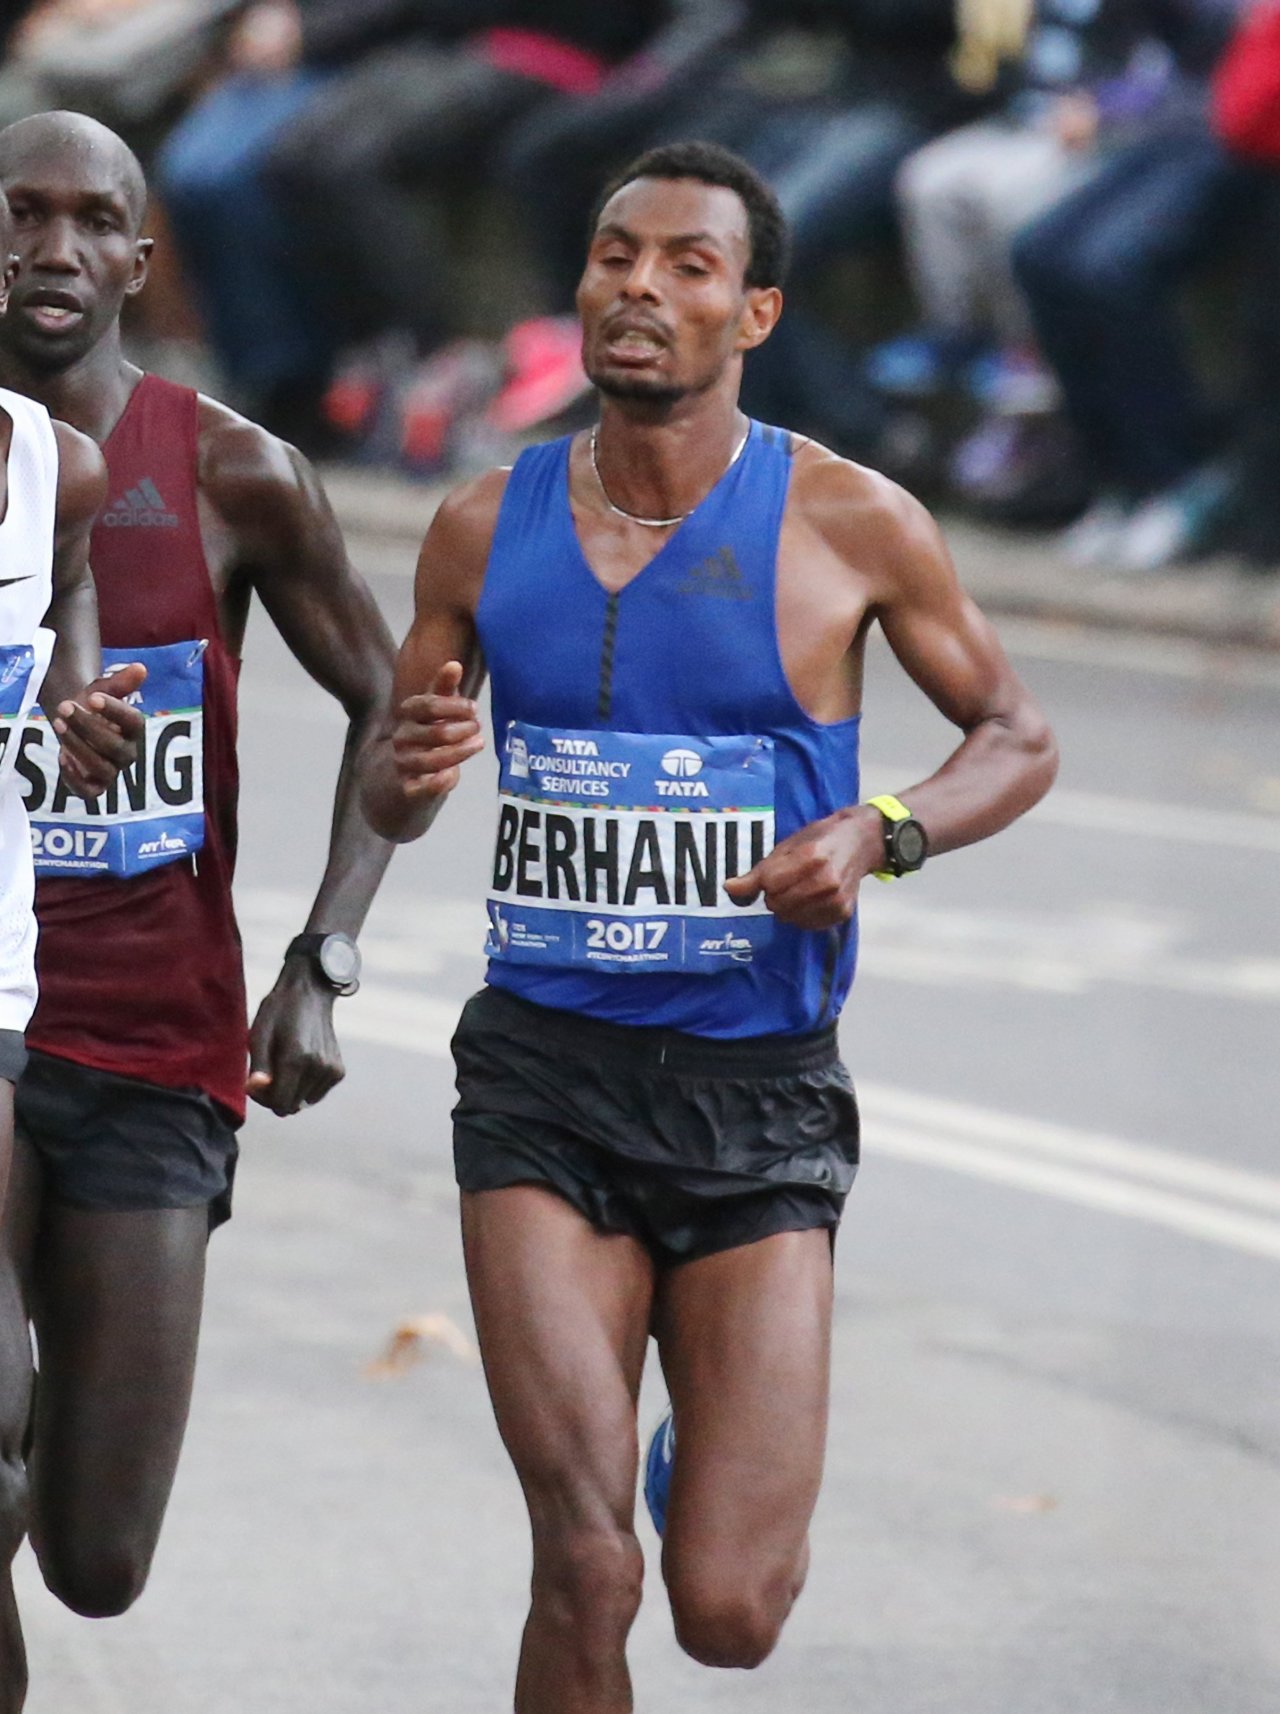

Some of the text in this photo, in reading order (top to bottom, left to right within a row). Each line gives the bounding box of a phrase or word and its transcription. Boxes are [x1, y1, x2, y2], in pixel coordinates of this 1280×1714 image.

[104, 508, 179, 527] adidas
[552, 739, 599, 756] TATA
[529, 755, 631, 778] CONSULTANCY
[541, 776, 610, 796] SERVICES
[655, 781, 709, 797] TATA
[31, 827, 109, 858] 2017
[492, 803, 764, 908] BERHANU
[586, 919, 669, 950] 2017
